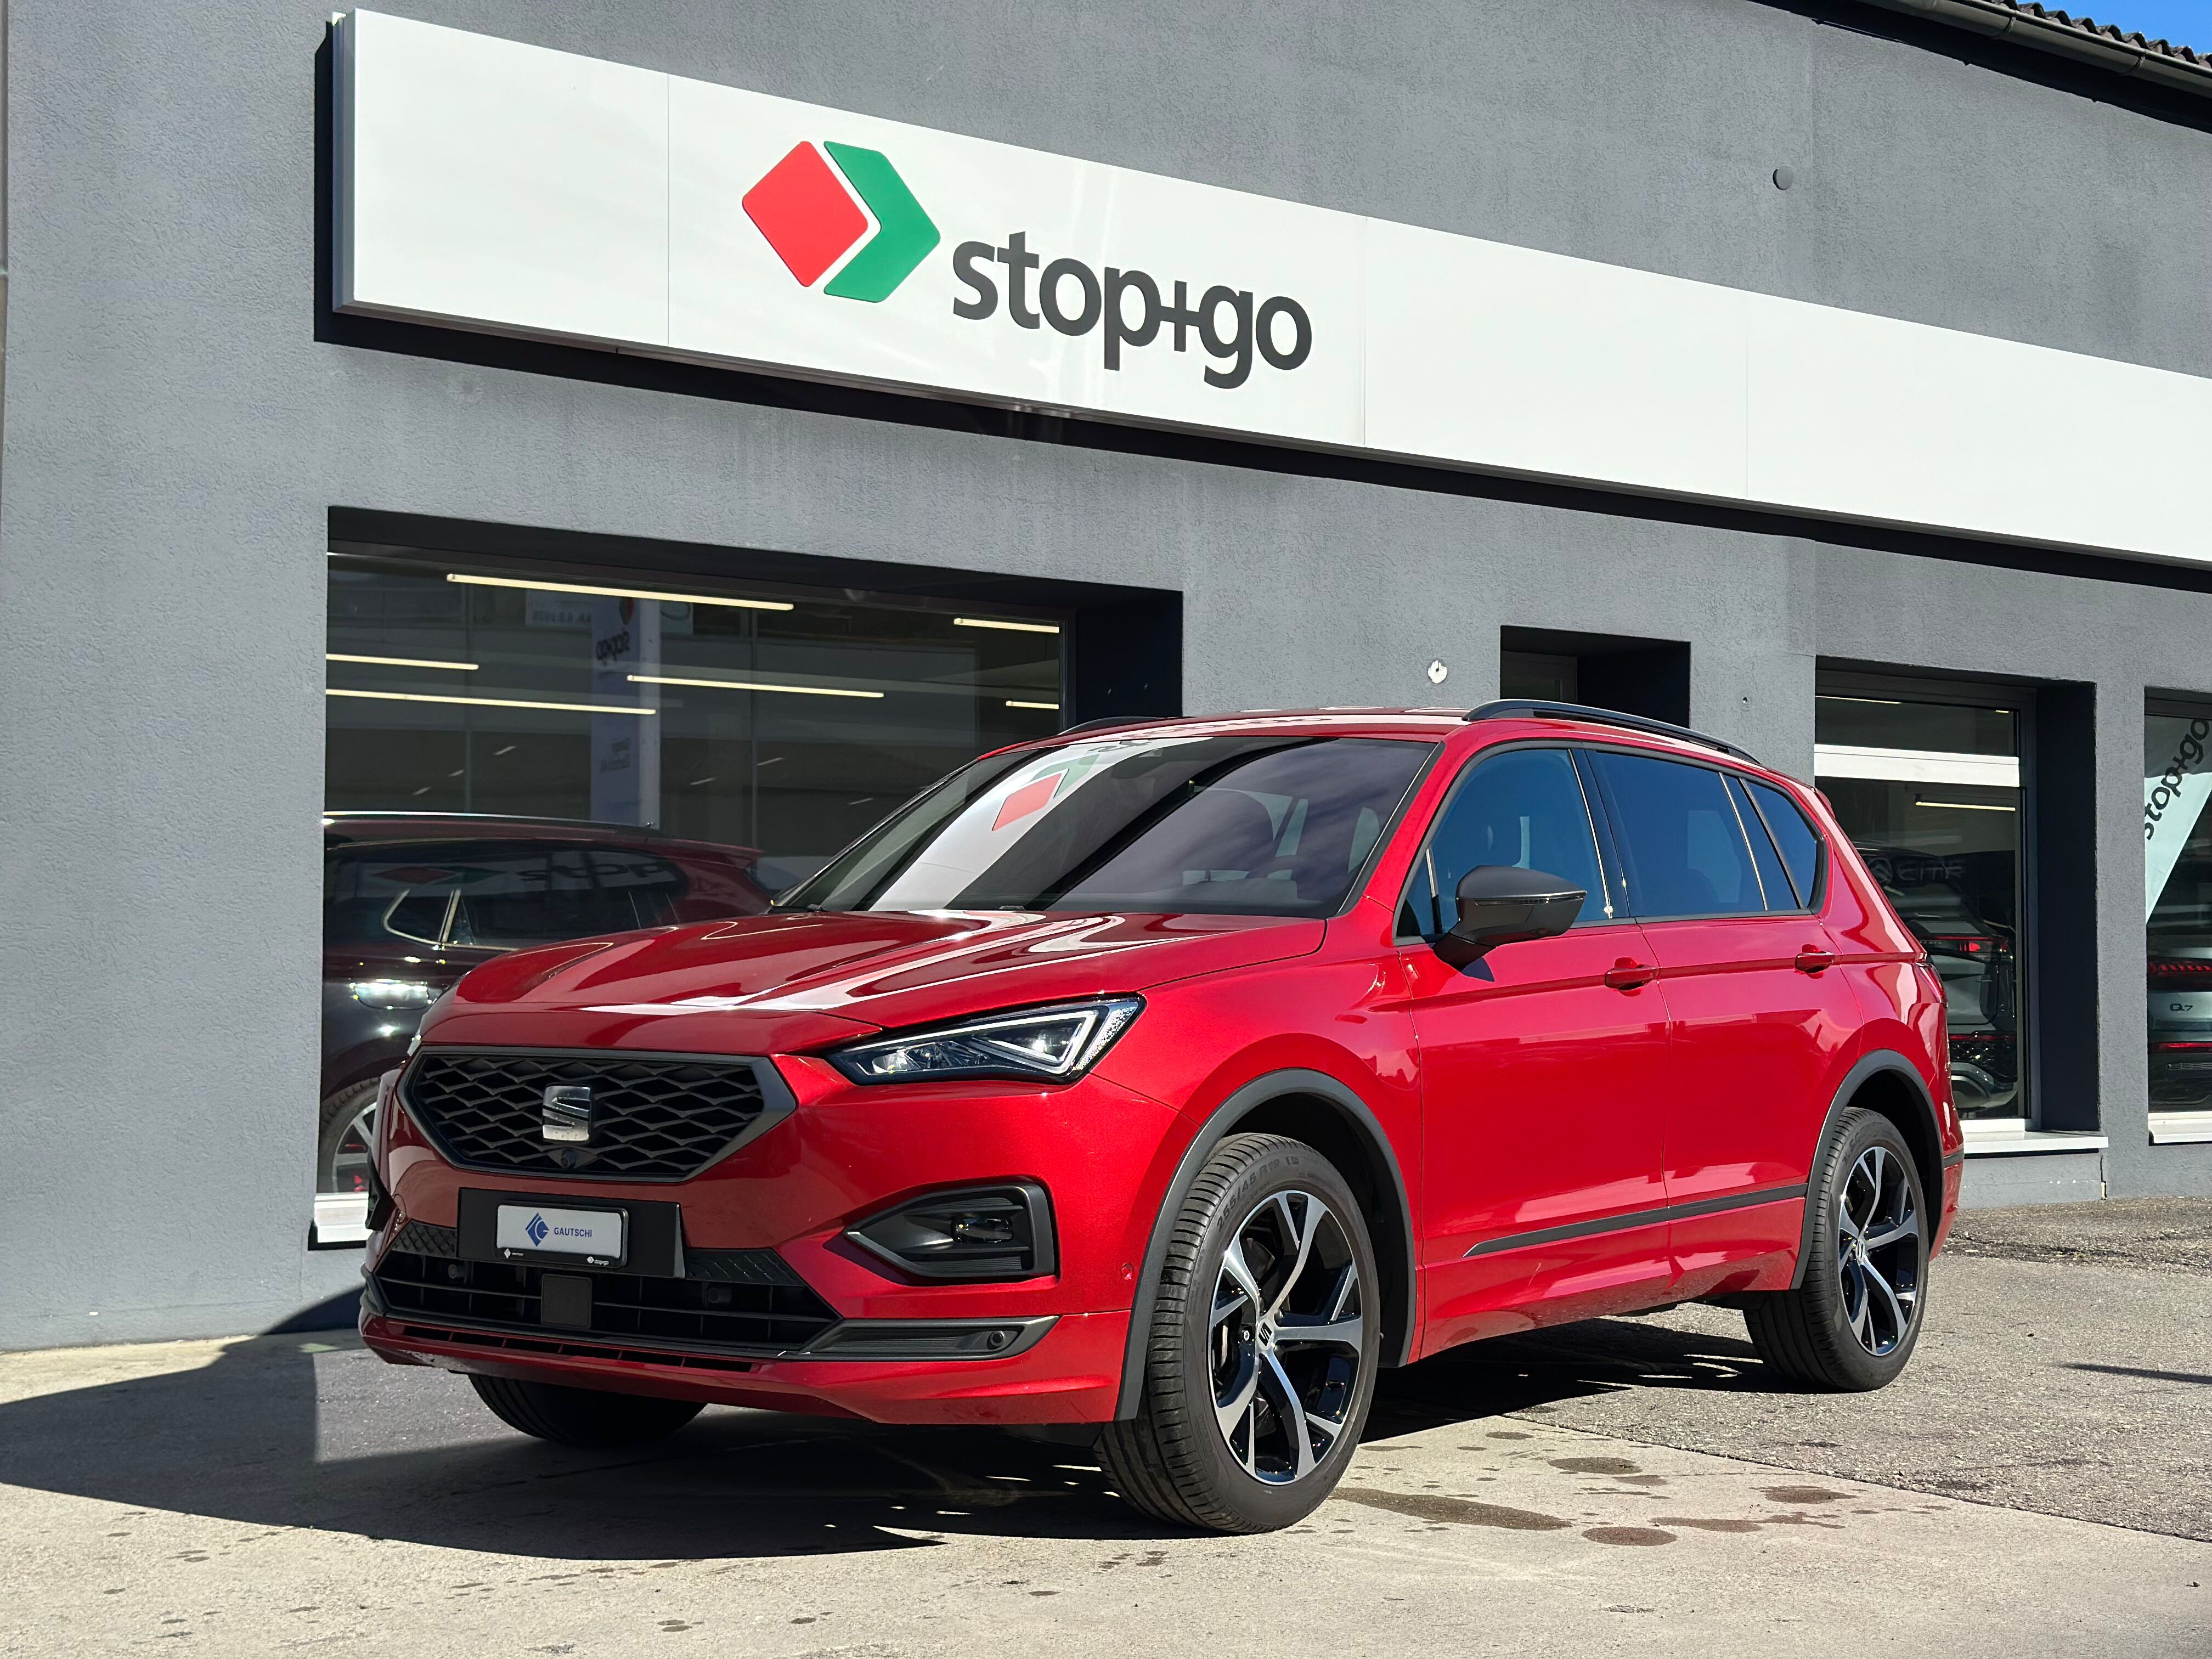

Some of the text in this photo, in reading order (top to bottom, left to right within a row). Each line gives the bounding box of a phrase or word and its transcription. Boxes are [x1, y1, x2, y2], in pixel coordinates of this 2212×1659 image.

[953, 231, 1312, 389] stop+go
[2169, 1003, 2193, 1012] Q7
[554, 1227, 592, 1238] GAUTSCHI
